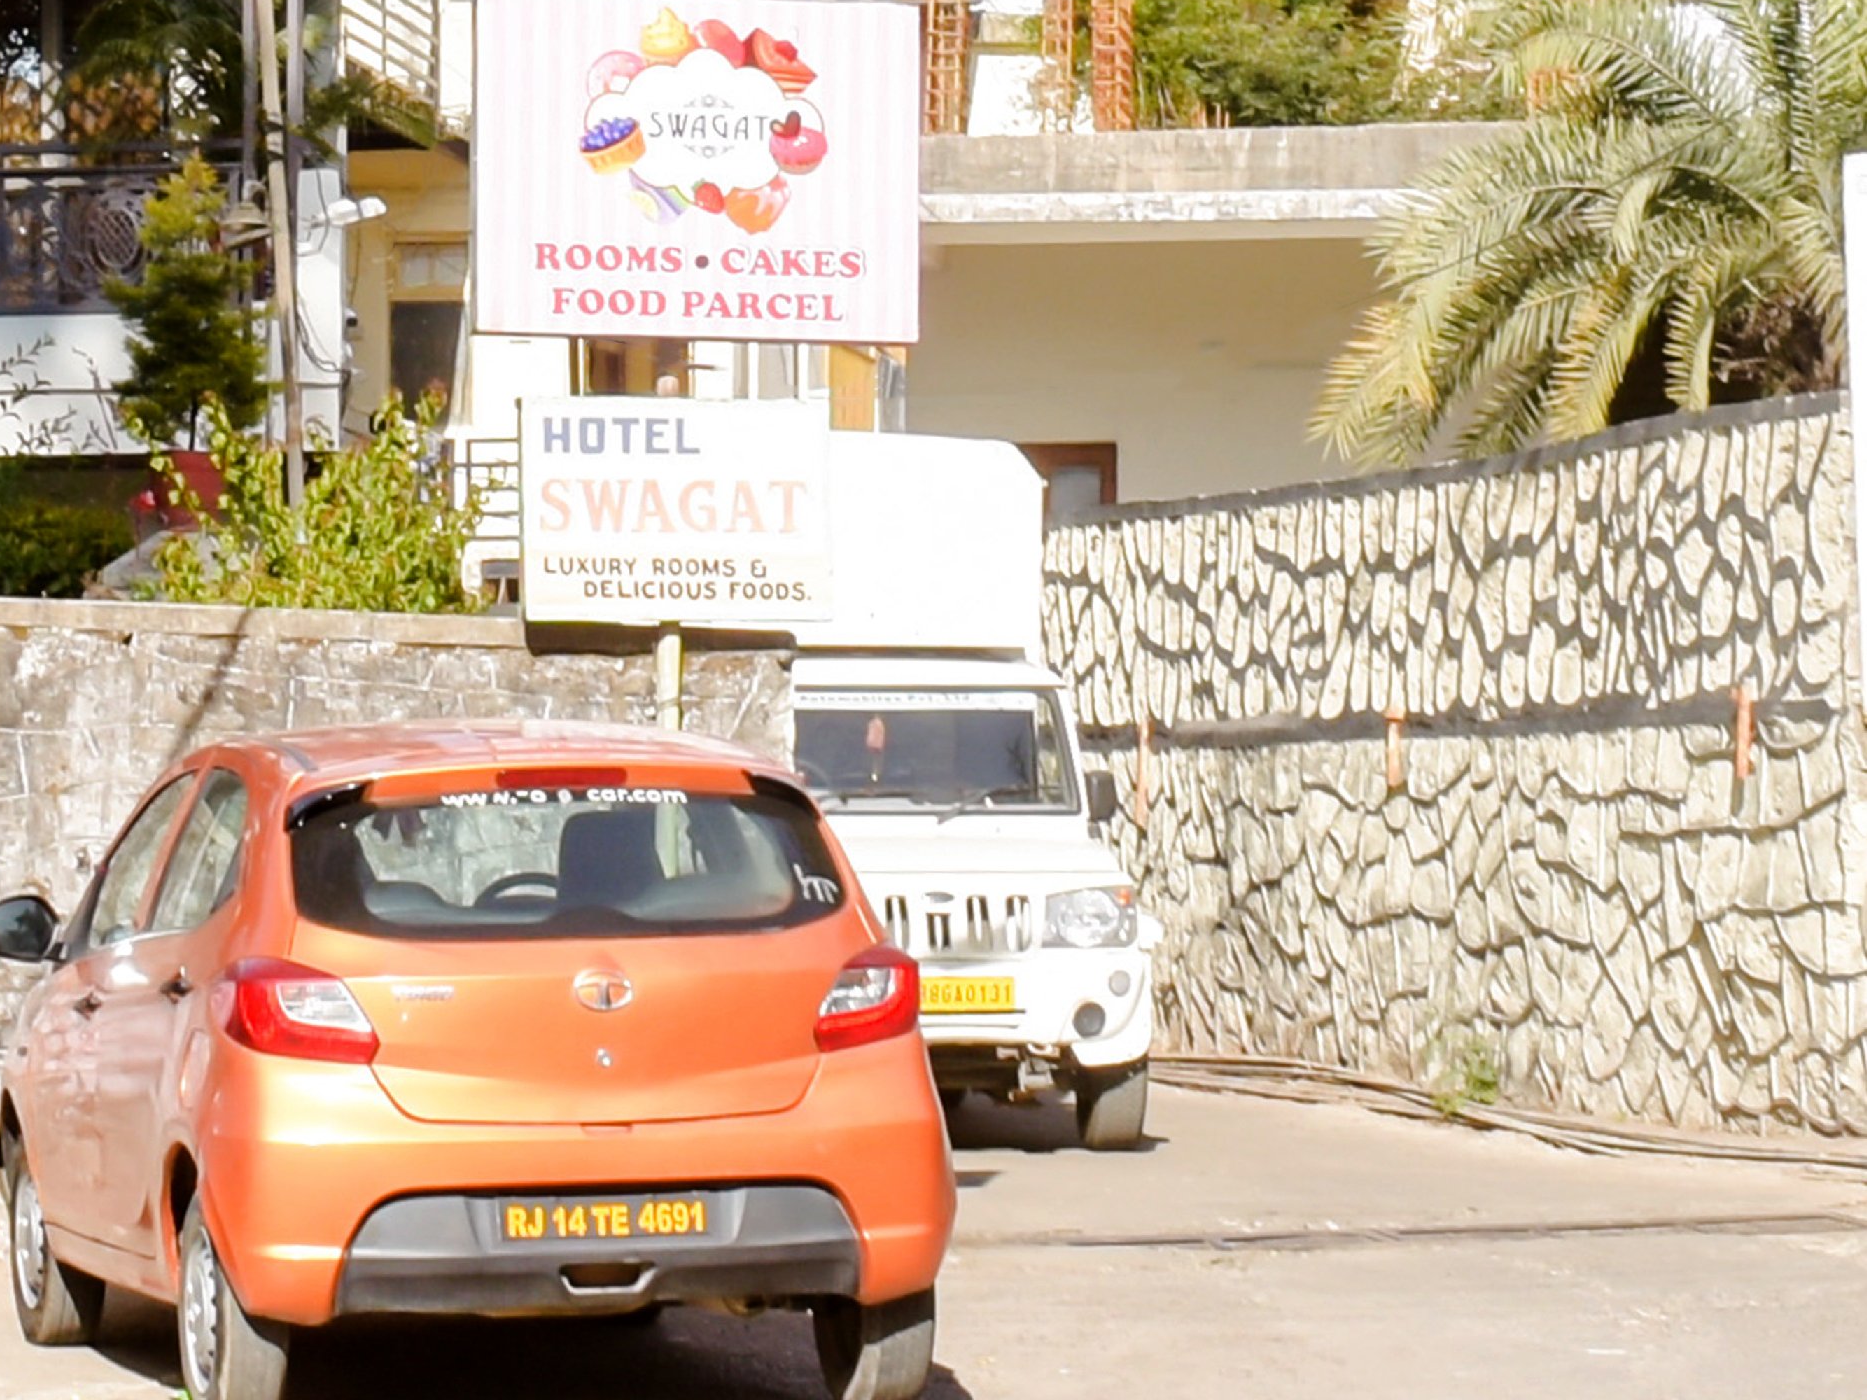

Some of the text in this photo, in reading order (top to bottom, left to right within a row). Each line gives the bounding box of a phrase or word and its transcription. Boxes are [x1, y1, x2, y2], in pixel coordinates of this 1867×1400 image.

[648, 111, 770, 142] SWAGAT
[534, 243, 863, 278] ROOMS CAKES
[552, 287, 844, 322] FOOD PARCEL
[543, 417, 700, 454] HOTEL
[539, 478, 808, 534] SWAGAT
[544, 556, 767, 579] LUXURY ROOMS &
[584, 580, 813, 602] DELICIOUS FOODS.
[506, 1201, 707, 1238] RJ 14 TE 4691
